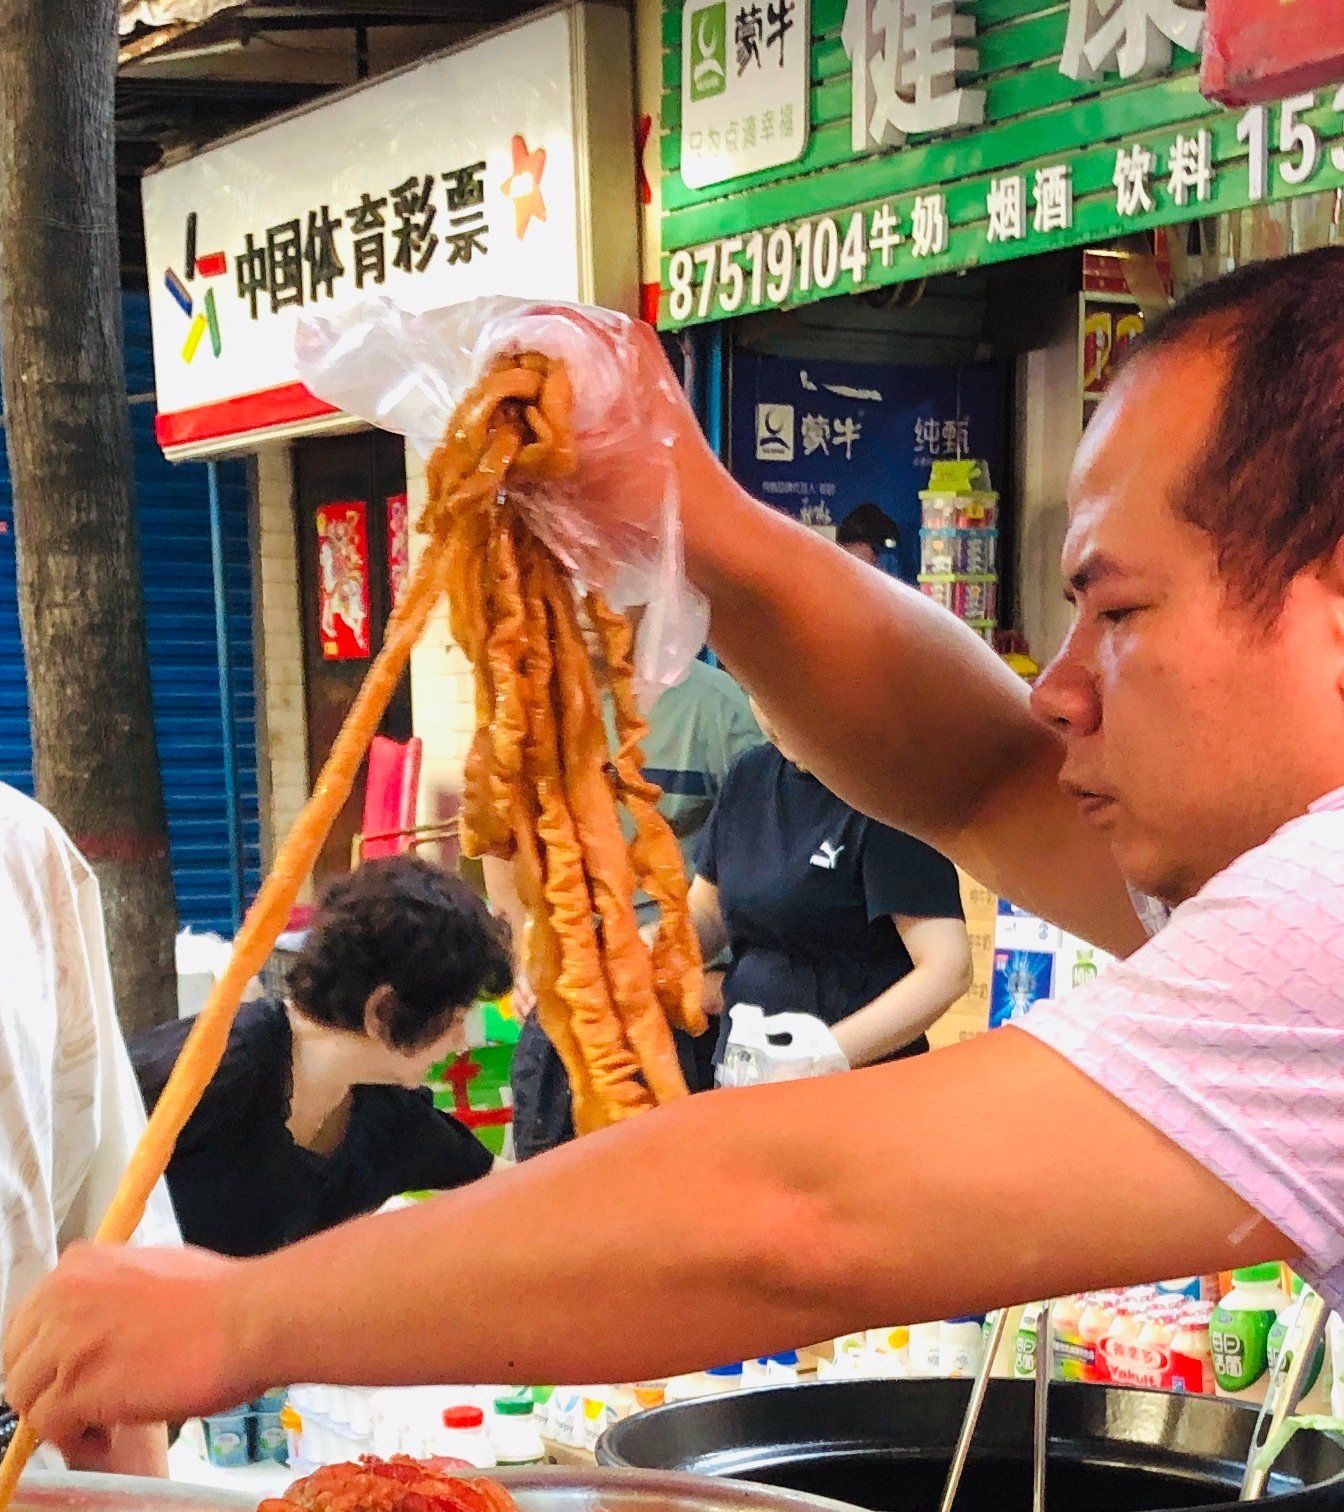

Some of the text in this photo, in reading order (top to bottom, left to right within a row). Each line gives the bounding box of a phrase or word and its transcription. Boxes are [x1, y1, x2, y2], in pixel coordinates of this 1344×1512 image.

[734, 0, 795, 78] 蒙牛
[234, 160, 489, 320] 中国体育彩票
[668, 211, 867, 321] 87519104
[869, 194, 948, 267] 牛奶
[986, 164, 1073, 242] 烟酒
[1112, 128, 1213, 216] 饮料
[1111, 1364, 1158, 1389] Yakult
